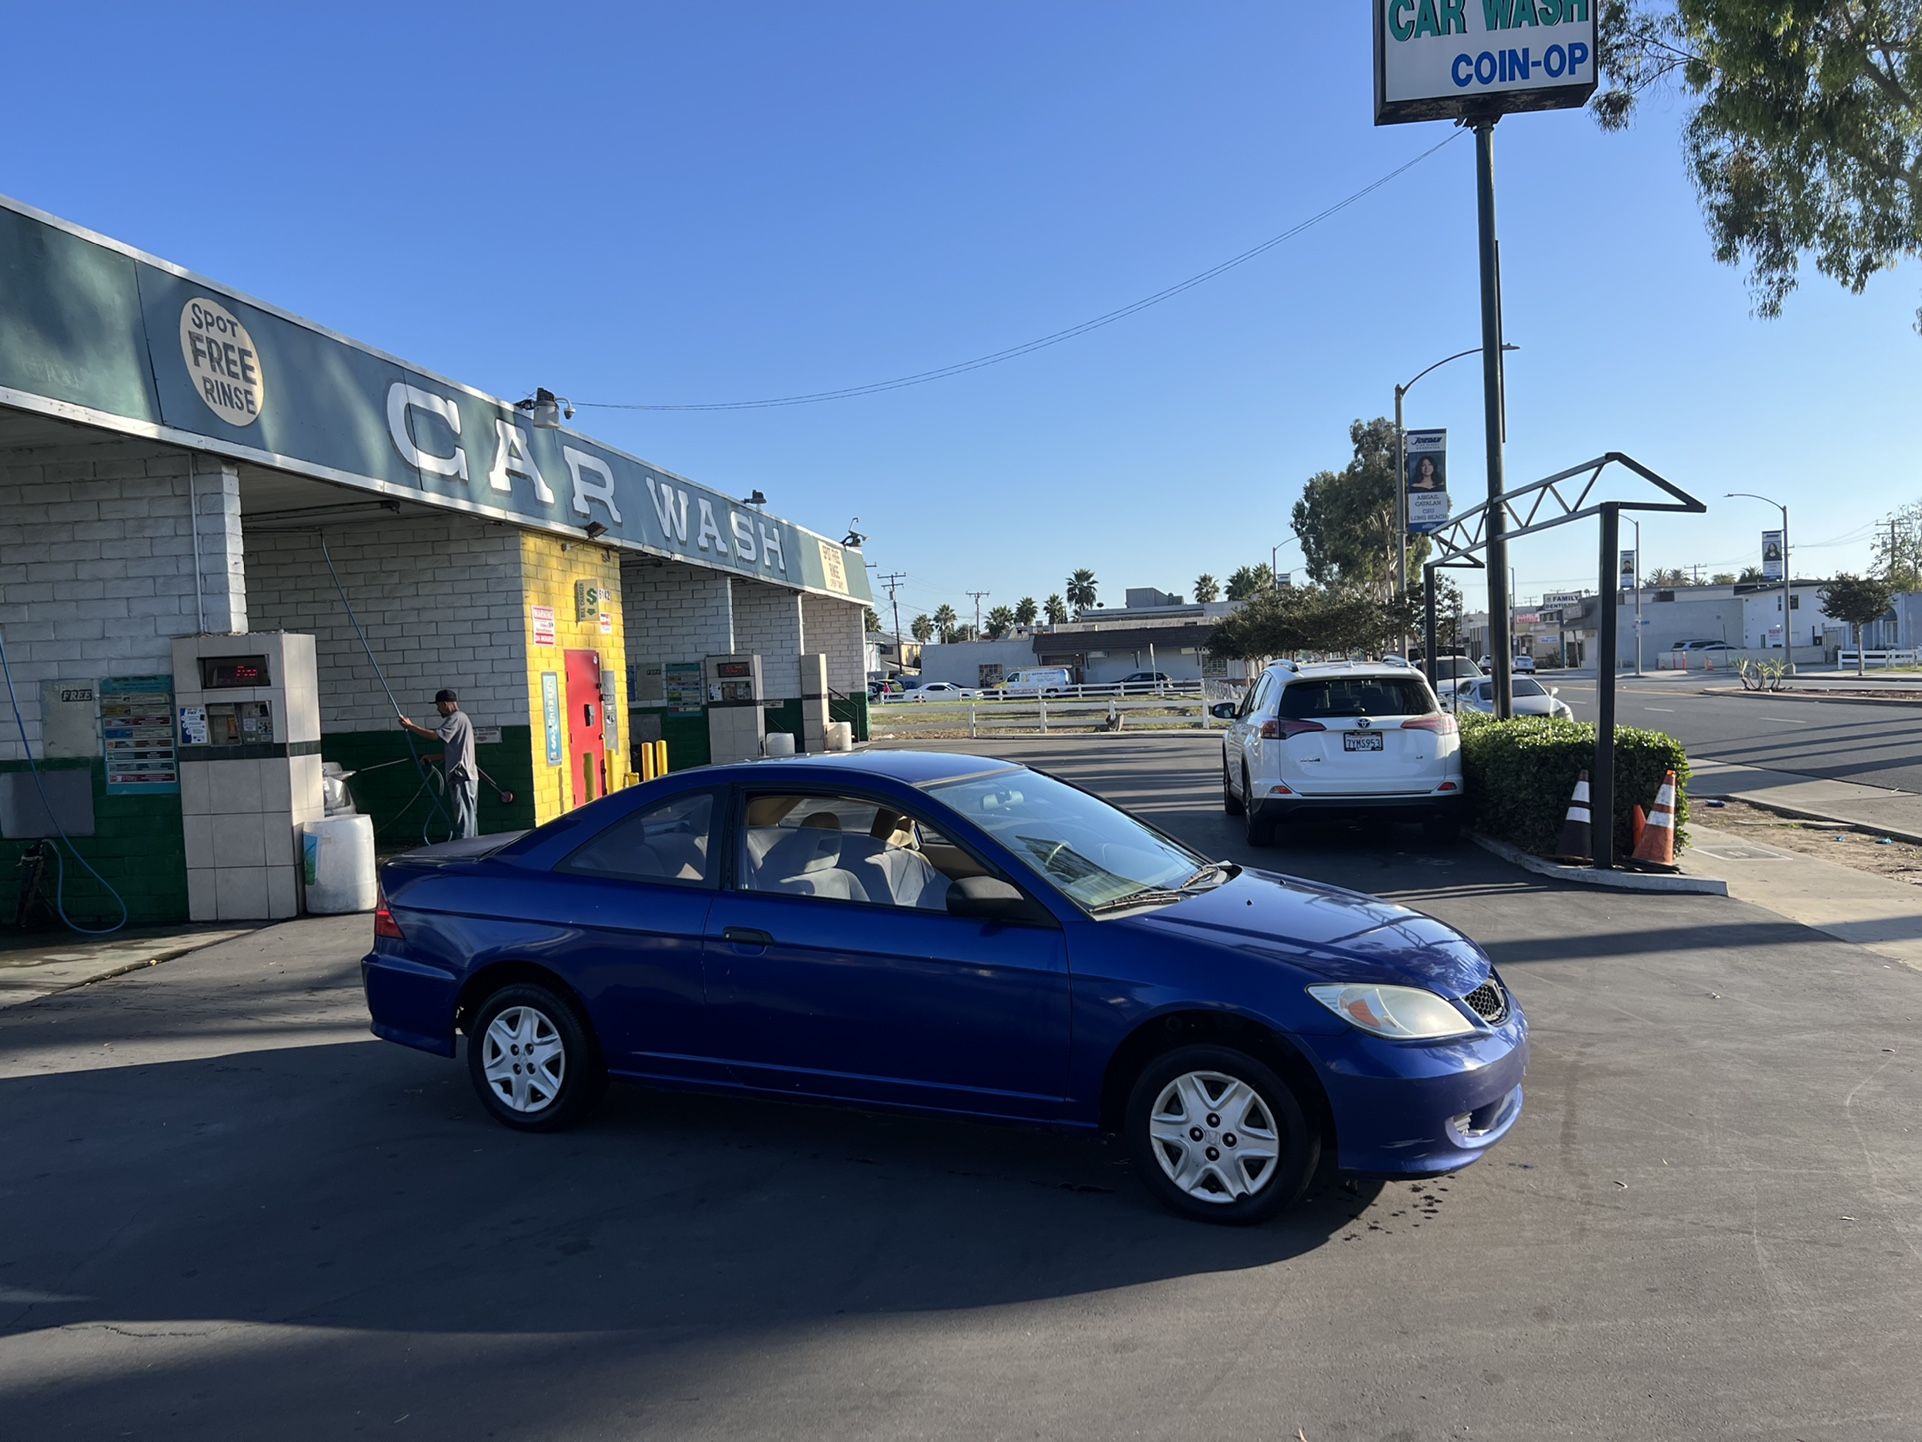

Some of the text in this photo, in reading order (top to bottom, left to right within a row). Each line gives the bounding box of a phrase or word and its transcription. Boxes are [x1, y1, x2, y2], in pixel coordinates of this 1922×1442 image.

[1389, 0, 1467, 41] CAR
[1452, 42, 1589, 87] COIN-OP
[191, 303, 238, 338] SPOT
[188, 330, 258, 386] FREE
[202, 375, 257, 416] RINSE
[387, 382, 786, 572] CAR WASH
[1552, 594, 1579, 602] FAMILY
[62, 689, 92, 701] FREE
[1346, 739, 1381, 749] 7YMS953
